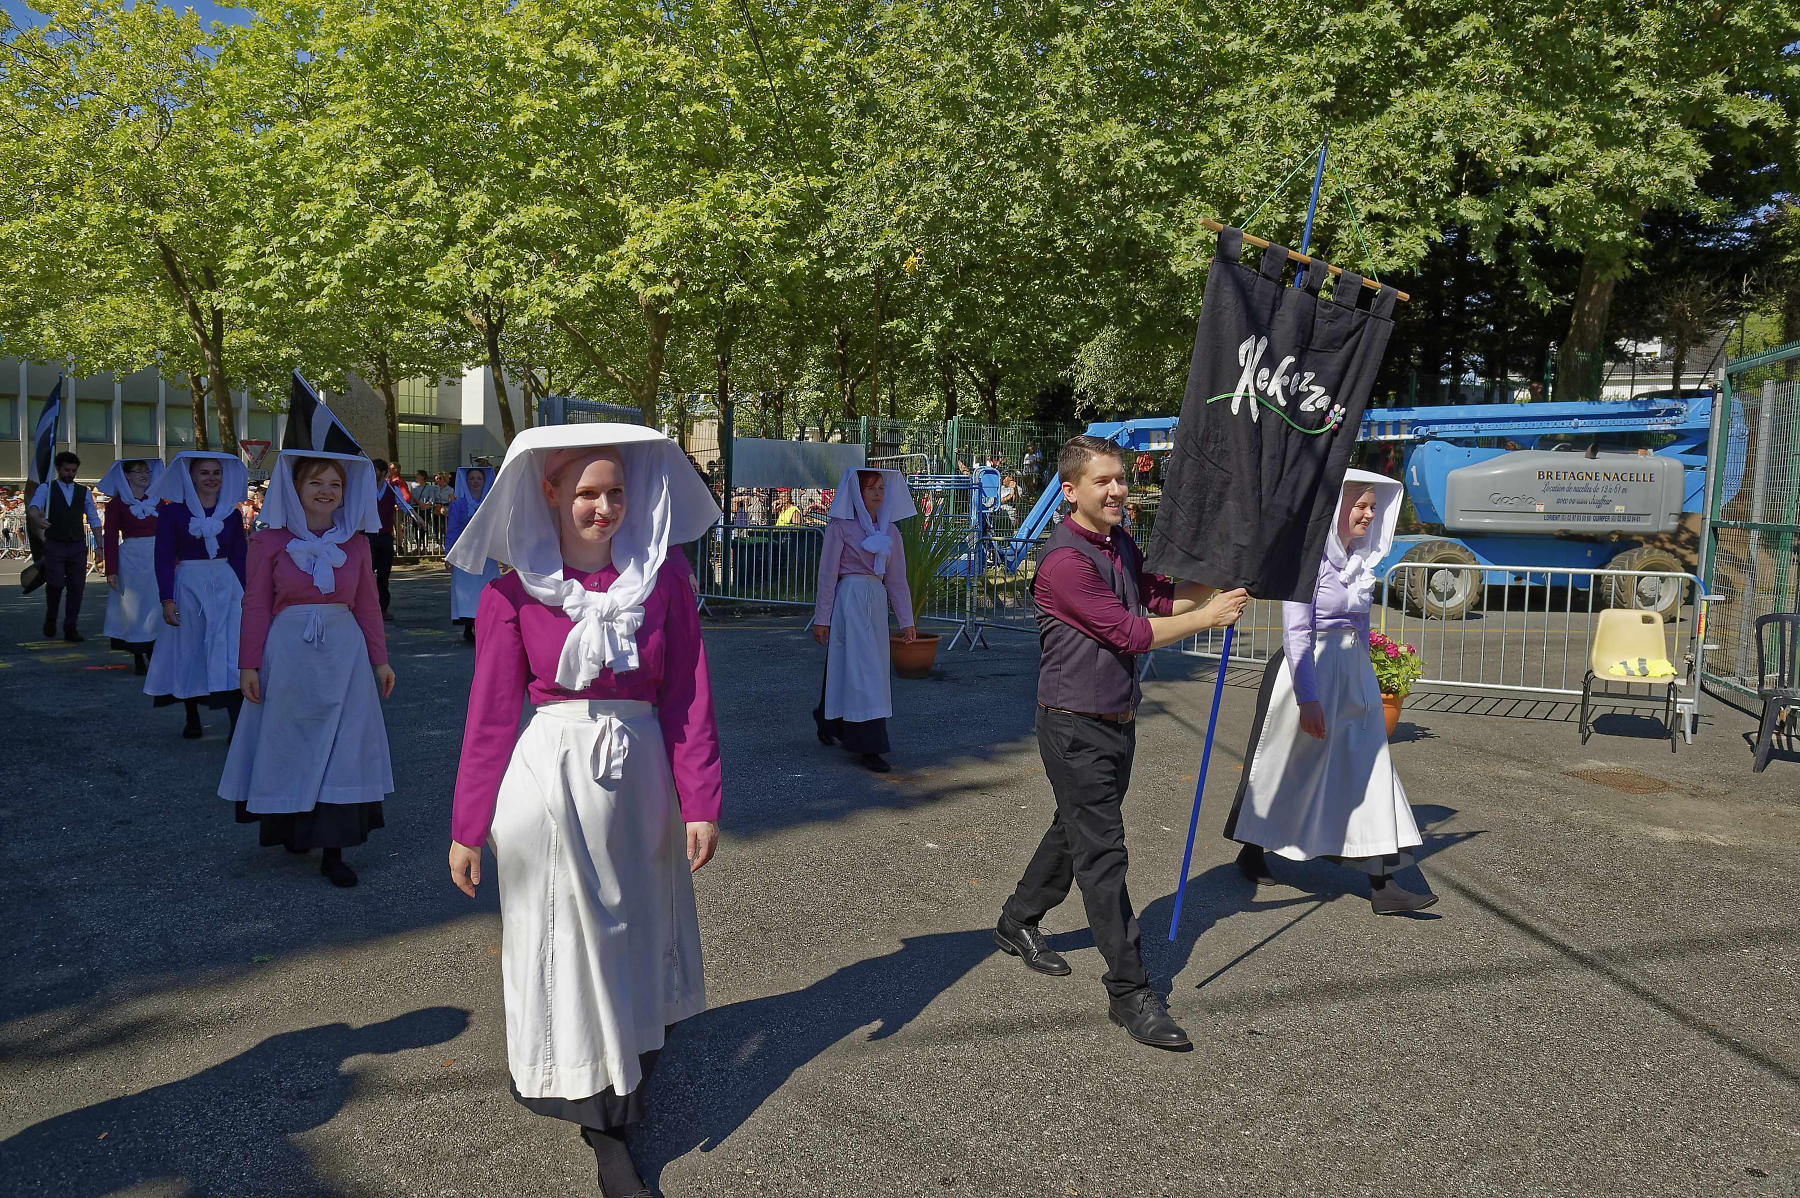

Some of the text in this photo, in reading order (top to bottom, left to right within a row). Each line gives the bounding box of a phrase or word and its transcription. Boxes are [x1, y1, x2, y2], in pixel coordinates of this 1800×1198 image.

[1536, 470, 1655, 482] BRETAGNE NACELLE
[1541, 481, 1565, 493] Location
